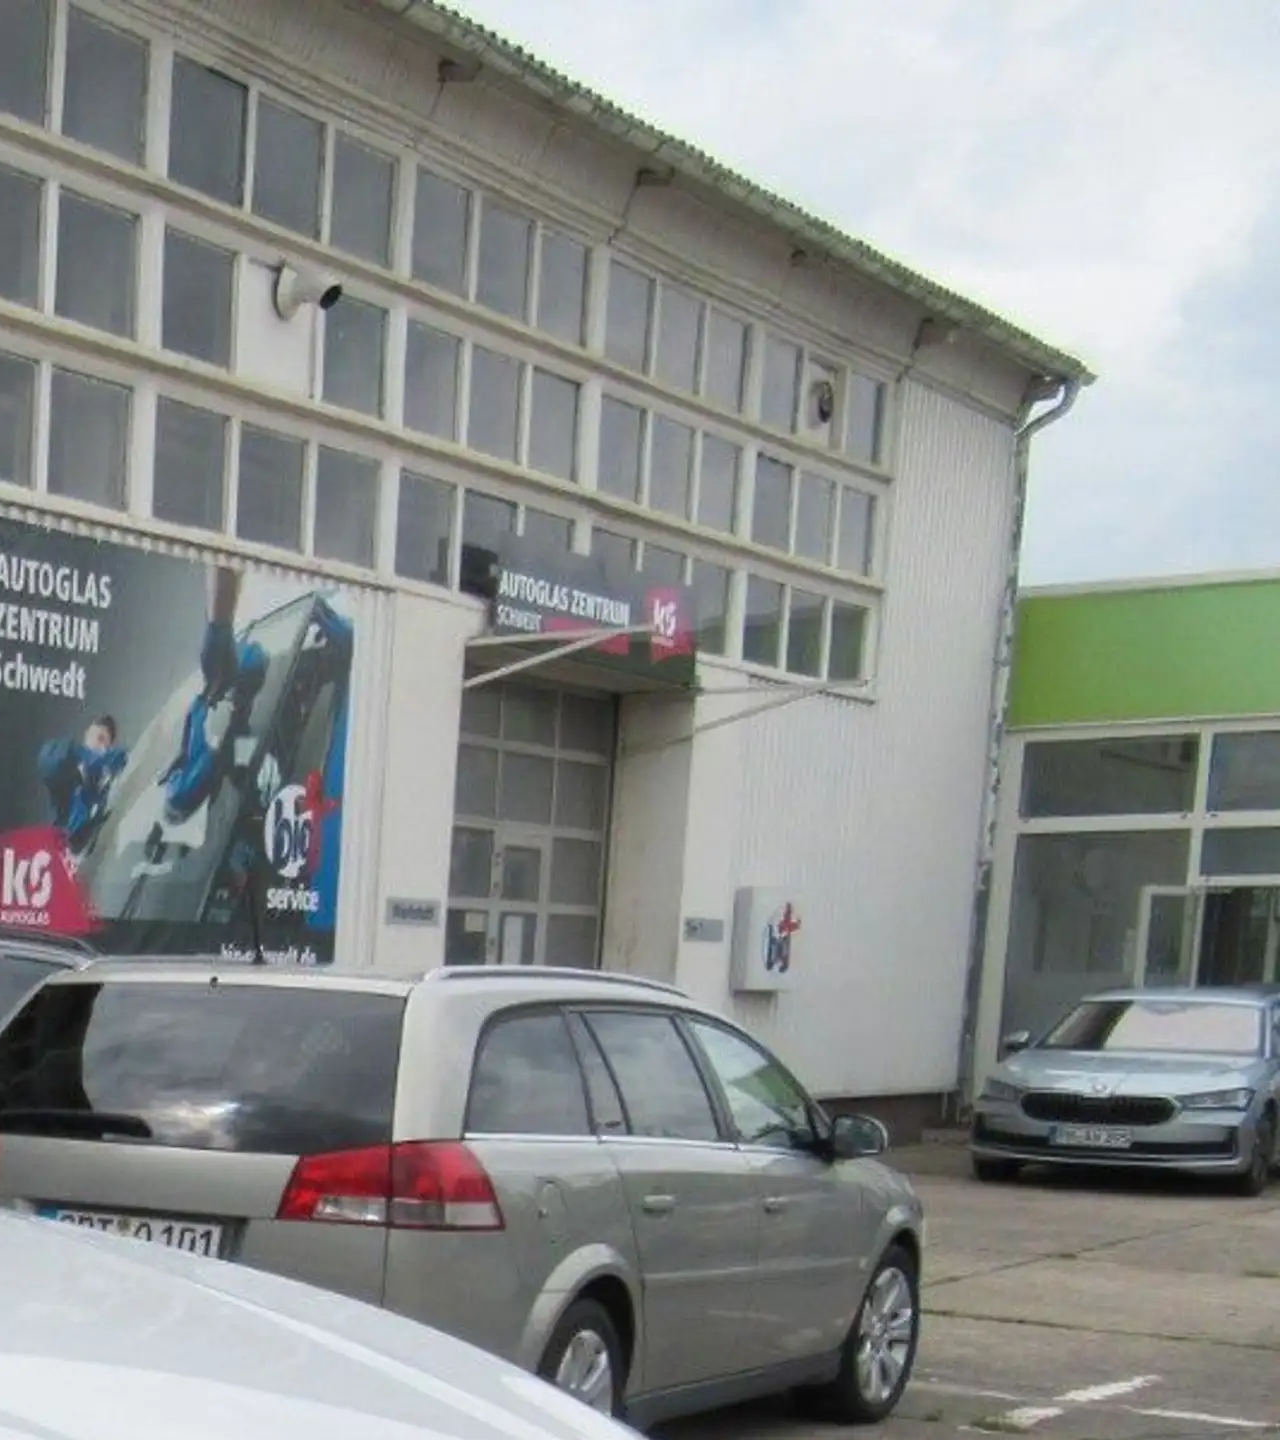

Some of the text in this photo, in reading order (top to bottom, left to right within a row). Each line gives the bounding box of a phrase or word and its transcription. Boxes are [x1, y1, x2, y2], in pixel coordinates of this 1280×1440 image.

[500, 570, 630, 628] AUTOGLAS ZENTRUM
[266, 884, 320, 912] service
